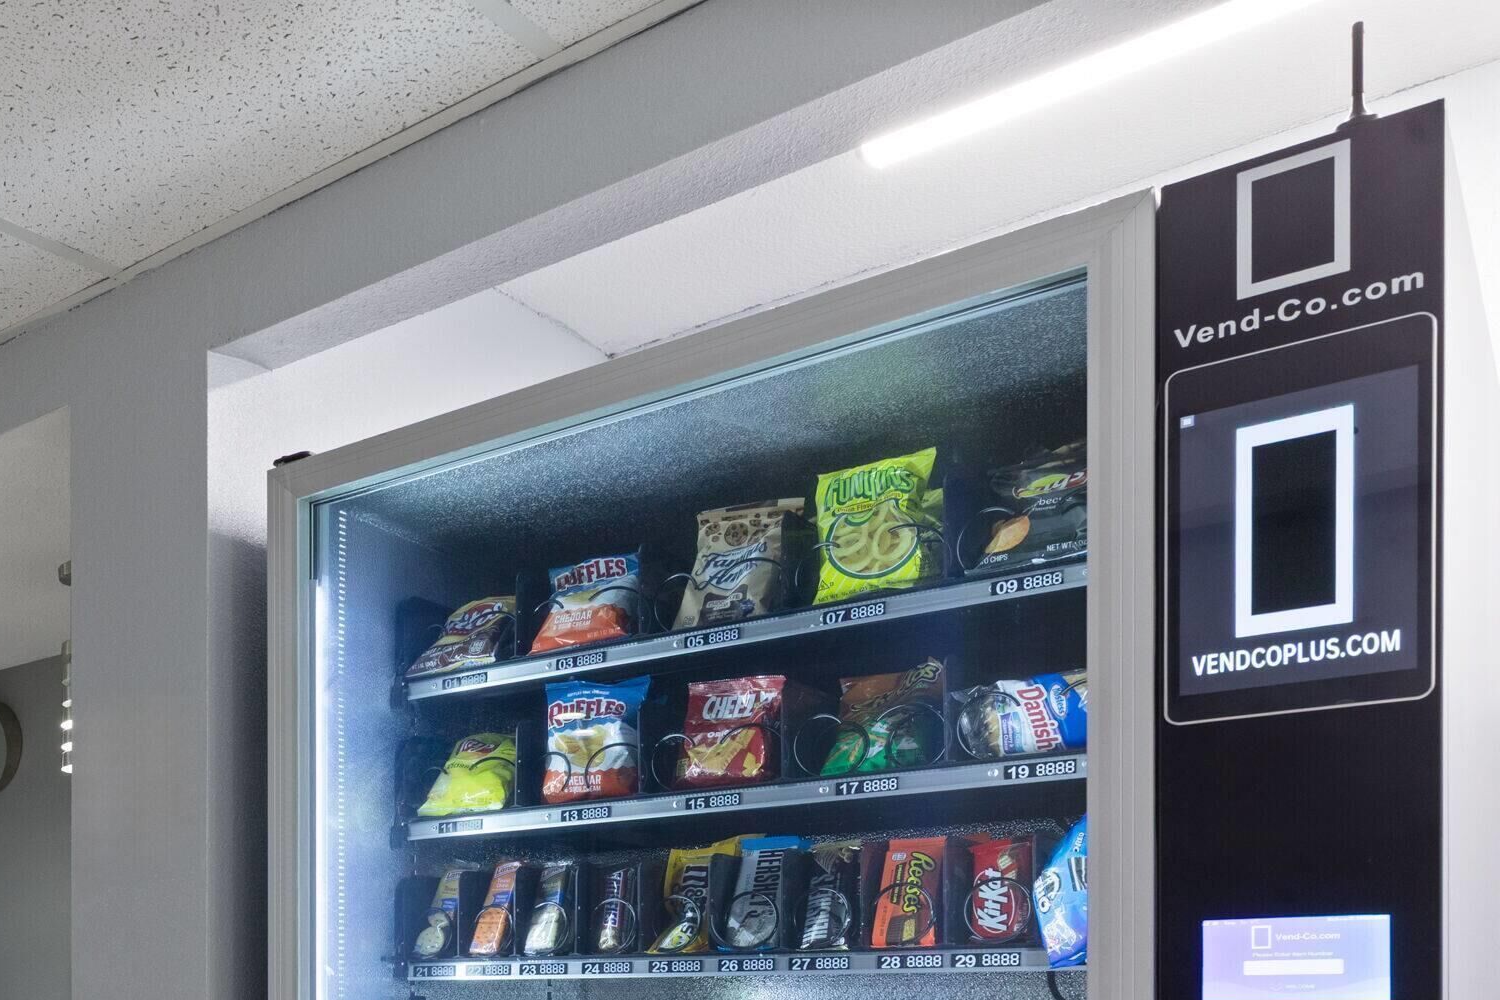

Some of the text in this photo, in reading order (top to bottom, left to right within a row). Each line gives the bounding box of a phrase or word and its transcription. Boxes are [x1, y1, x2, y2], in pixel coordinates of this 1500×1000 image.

[1175, 271, 1425, 348] Vend-Co.com
[555, 558, 628, 591] RUFFLES
[996, 572, 1062, 595] 09 8888
[554, 610, 592, 624] CHEDDAR
[826, 603, 885, 624] 07 8888
[687, 629, 739, 648] 05 8888
[1192, 630, 1401, 676] VENDCOPLUS.COM
[559, 653, 603, 671] 03 8888
[445, 678, 459, 690] 01
[548, 697, 626, 729] RUFFLES
[1017, 686, 1060, 752] Danish
[1007, 761, 1075, 779] 19 8888
[840, 778, 898, 795] 17 8888
[688, 794, 740, 810] 15 8888
[563, 807, 609, 822] 13 8888
[441, 823, 454, 833] 11
[902, 851, 936, 914] Reese's
[1275, 931, 1341, 941] Vend-Co.com
[585, 962, 630, 974] 24 8888
[651, 961, 701, 973] 25 8888
[721, 959, 774, 972] 26 8888
[791, 957, 849, 971] 27 8888
[880, 955, 942, 969] 28 8888
[955, 953, 1020, 968] 29 8888
[416, 967, 428, 977] 21
[485, 965, 510, 975] 8888
[521, 963, 565, 976] 23 8888
